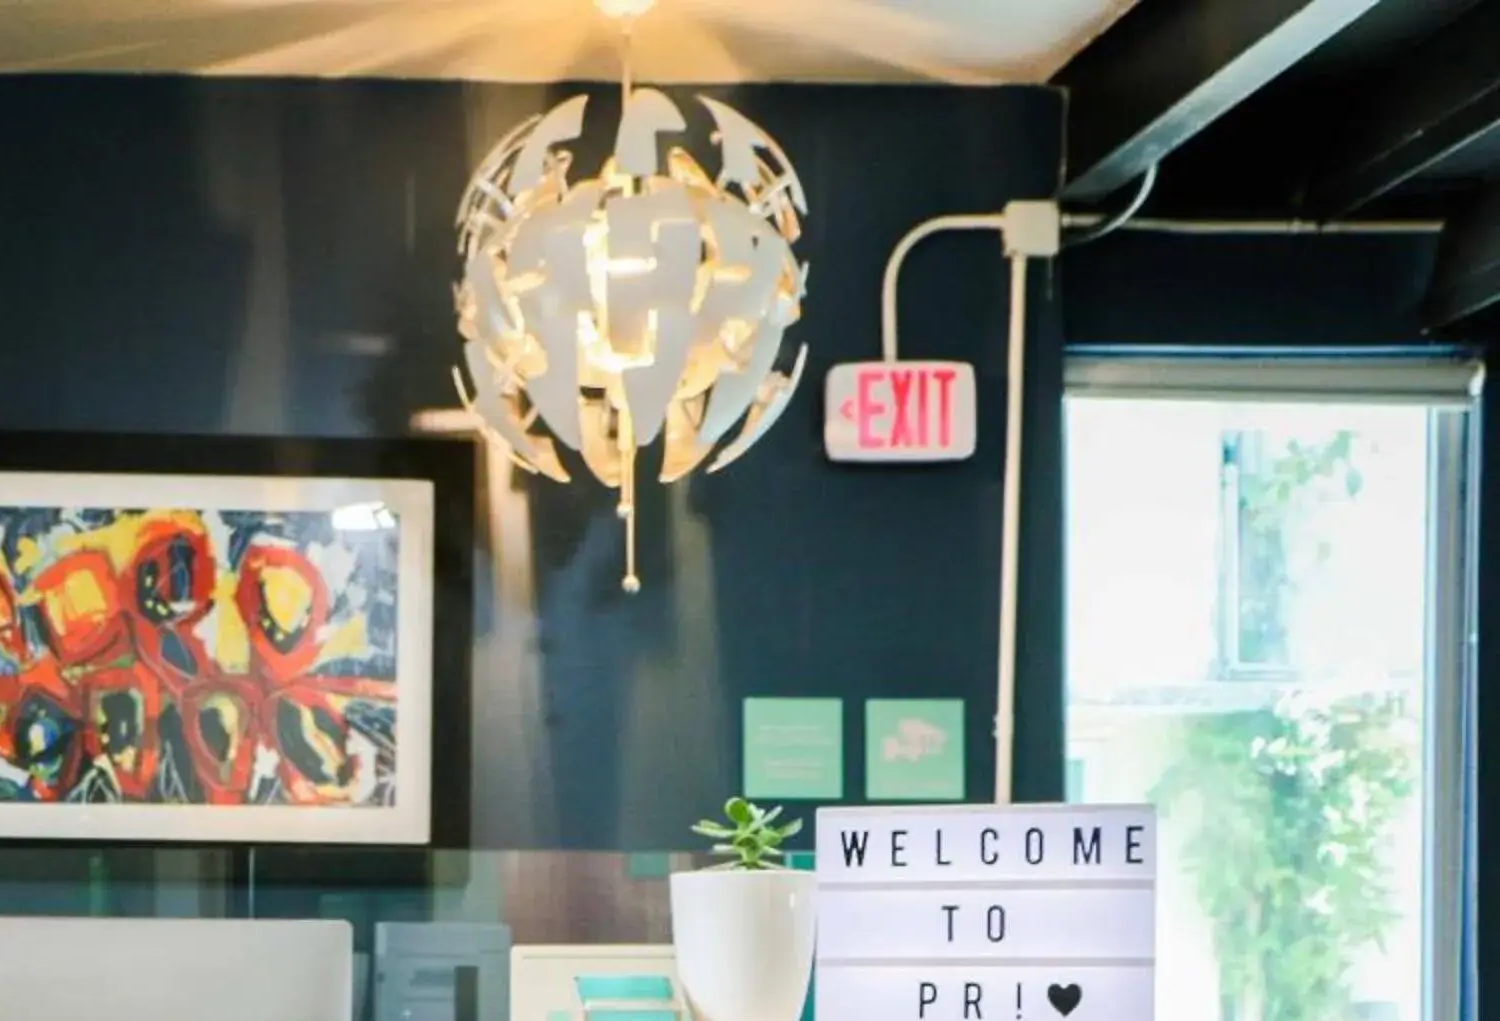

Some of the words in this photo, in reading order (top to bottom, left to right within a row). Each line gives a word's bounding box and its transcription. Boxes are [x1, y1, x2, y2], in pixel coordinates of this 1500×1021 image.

[858, 369, 957, 448] EXIT
[840, 824, 1145, 868] WELCOME
[940, 903, 1007, 944] TO
